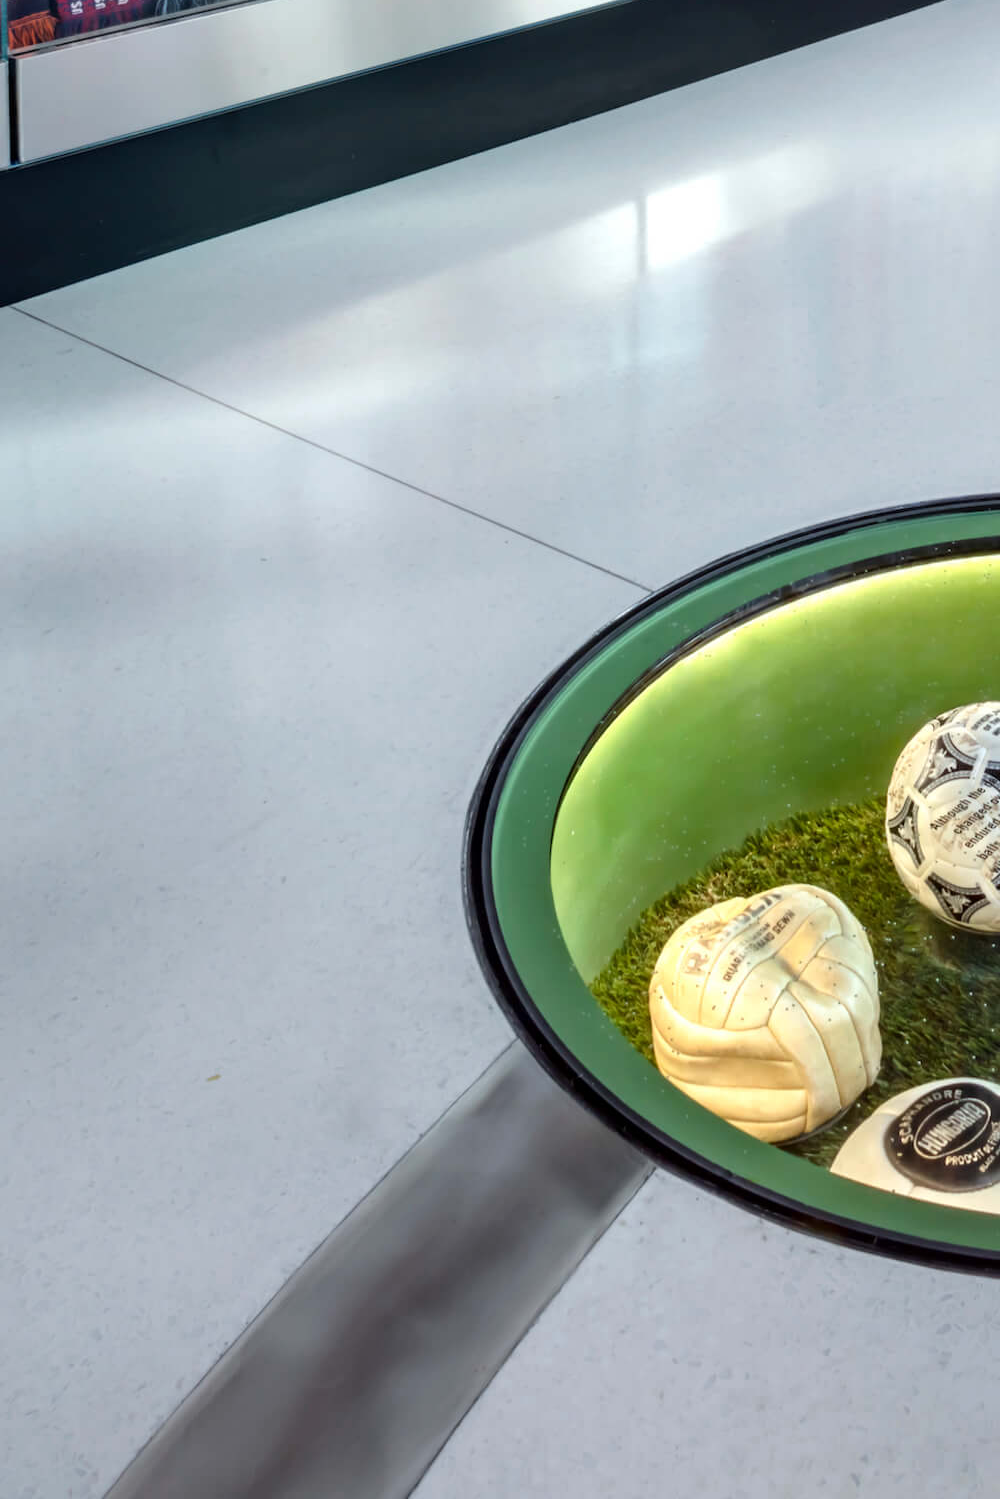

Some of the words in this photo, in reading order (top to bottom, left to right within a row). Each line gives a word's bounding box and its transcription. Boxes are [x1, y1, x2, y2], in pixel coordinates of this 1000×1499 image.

[929, 797, 971, 833] Although
[968, 785, 986, 801] the
[952, 800, 994, 836] changed
[917, 1101, 986, 1156] HUNGARIA
[944, 1145, 985, 1167] PRODUIT
